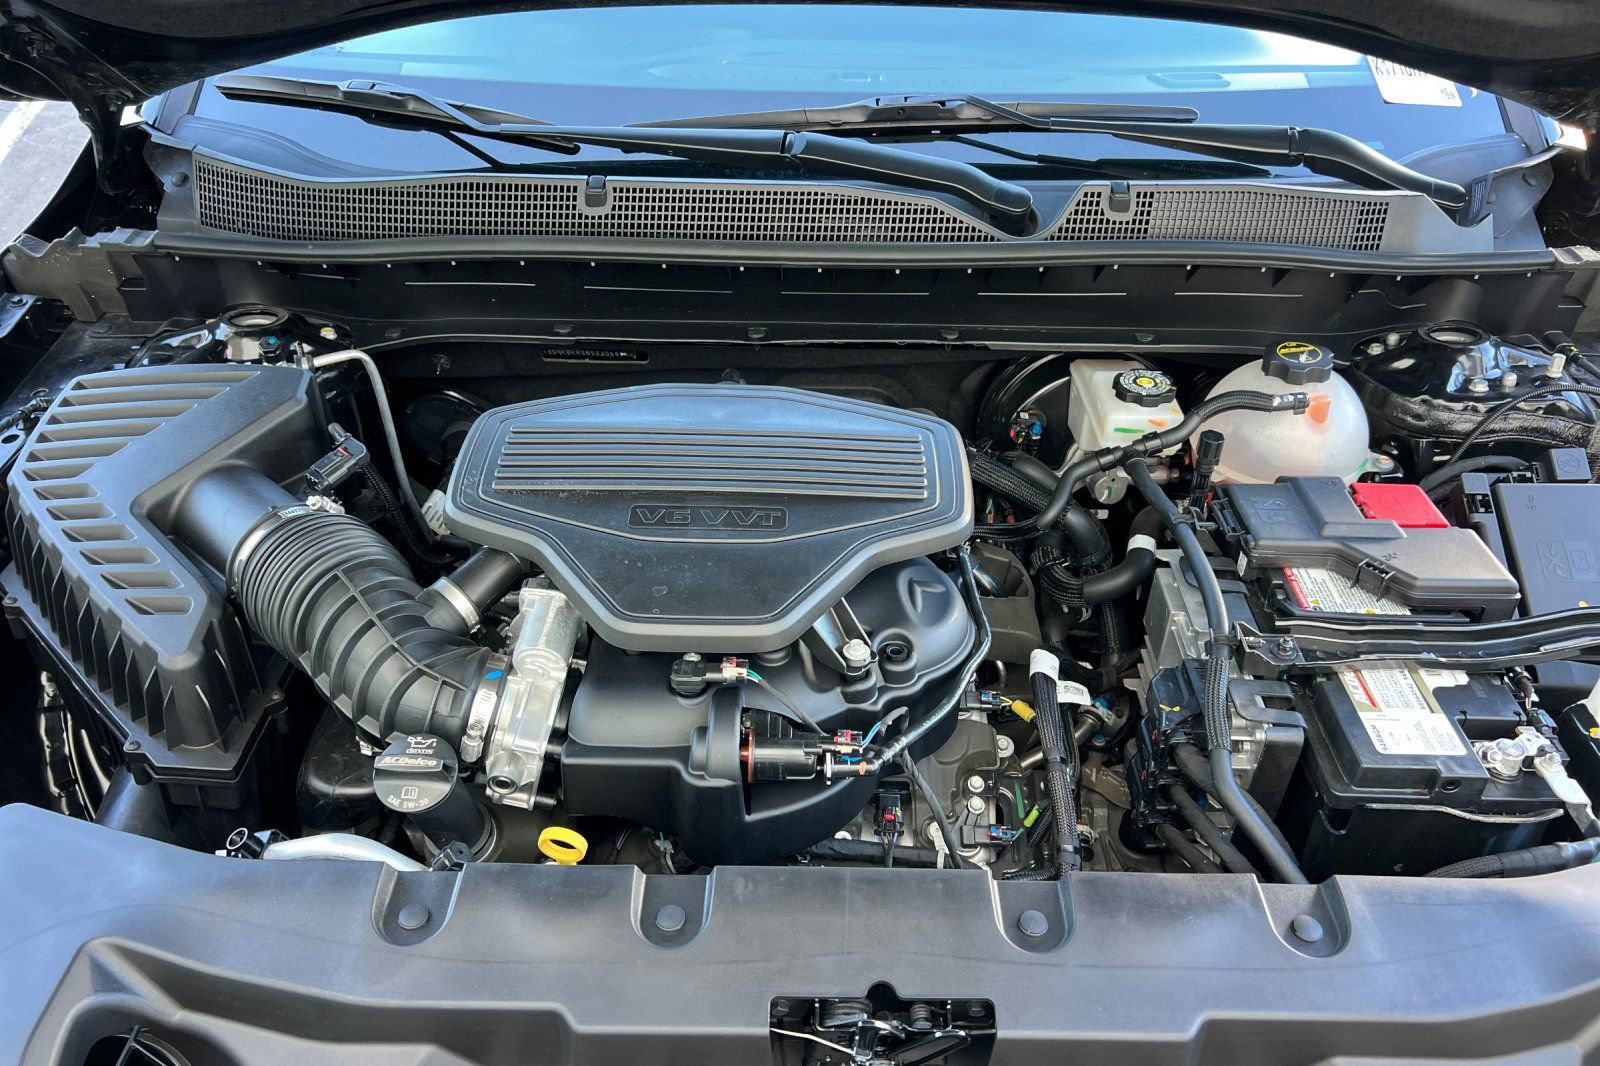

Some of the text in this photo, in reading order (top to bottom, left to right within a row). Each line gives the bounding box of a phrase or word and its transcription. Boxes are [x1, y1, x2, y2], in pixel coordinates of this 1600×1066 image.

[636, 508, 781, 526] V6 VVT
[1370, 724, 1389, 752] 94RAGM
[380, 756, 437, 766] ACDelco
[387, 795, 429, 808] SAE 5W-30
